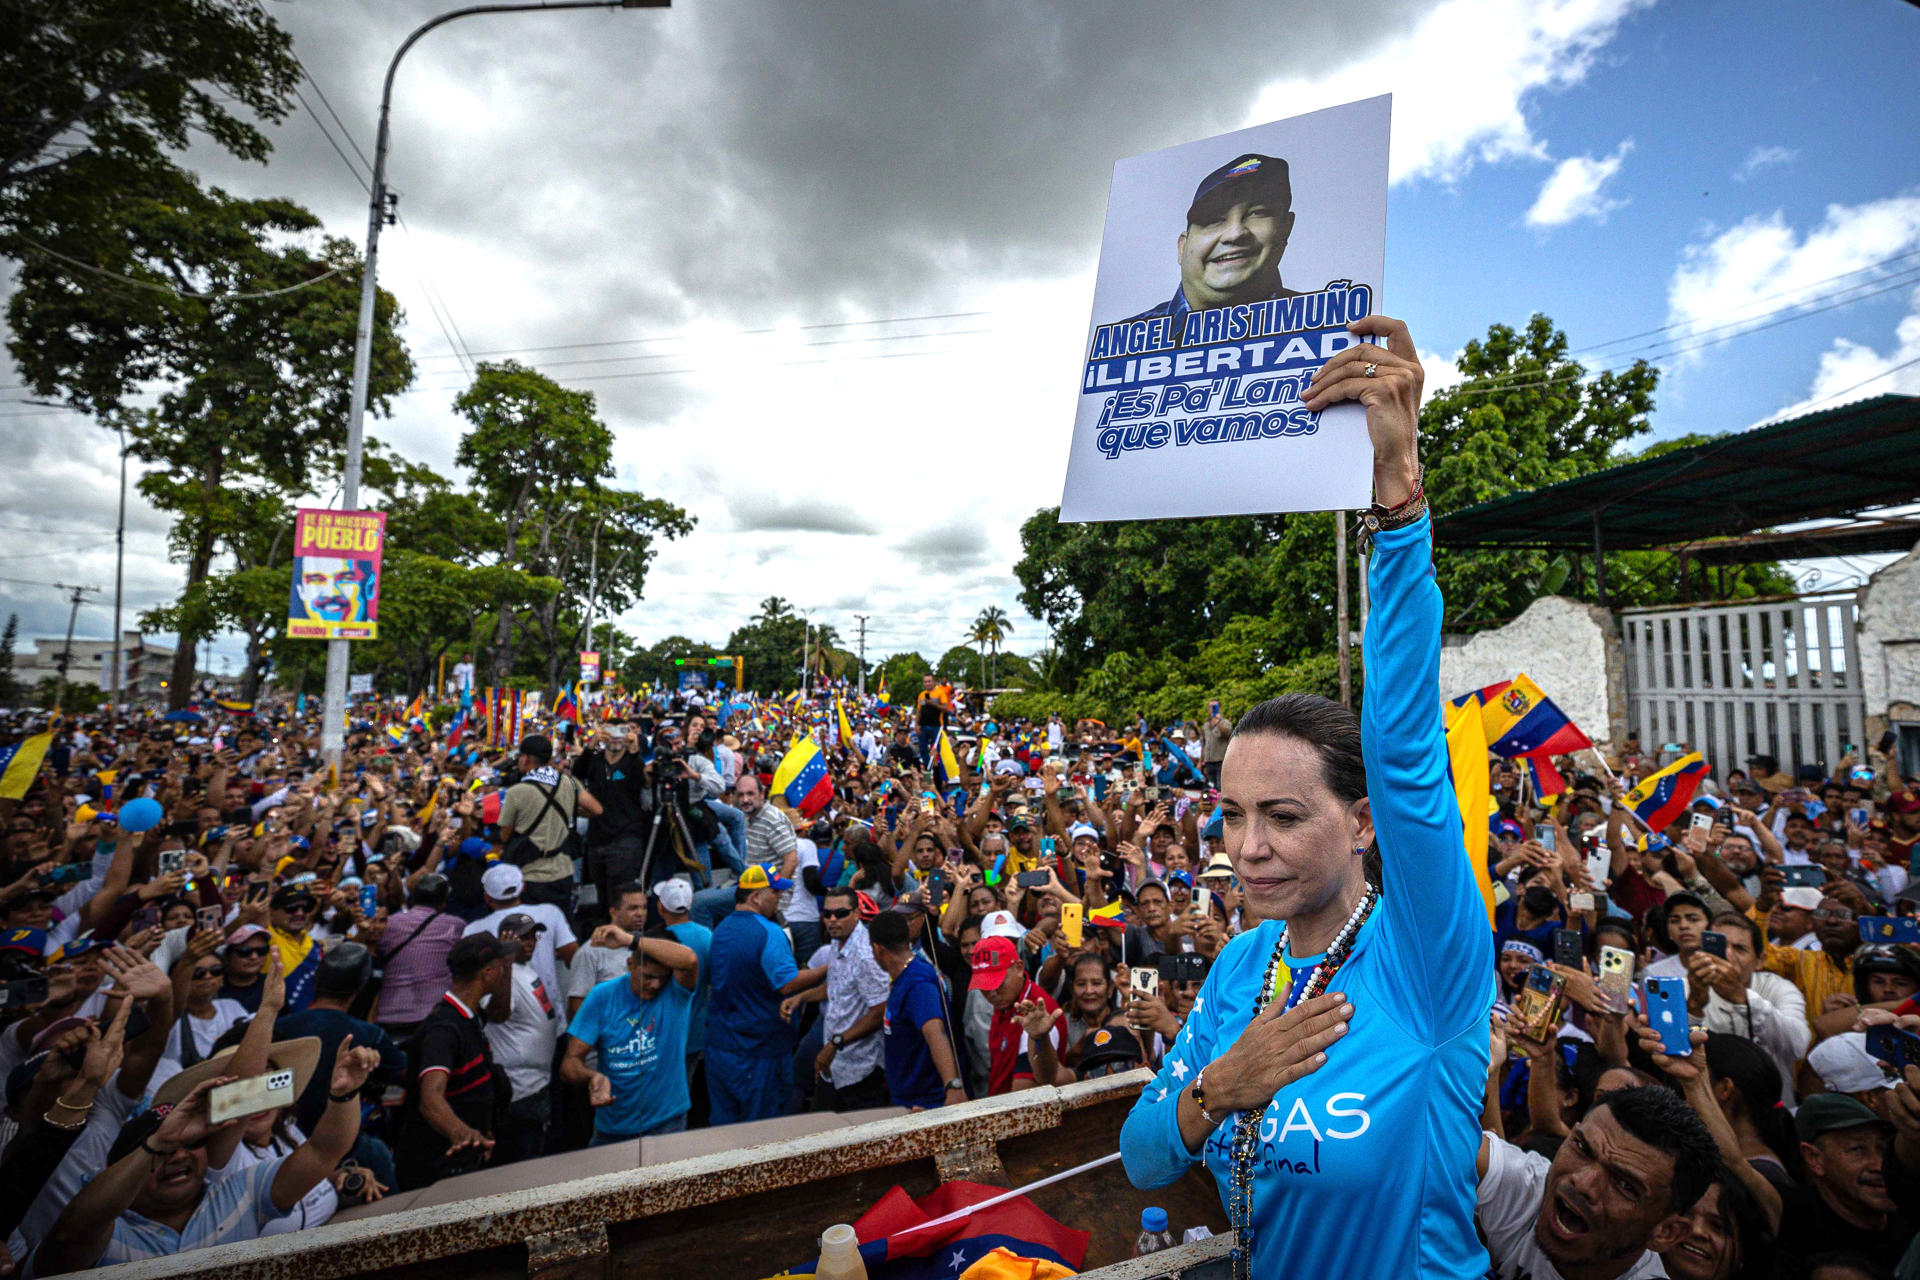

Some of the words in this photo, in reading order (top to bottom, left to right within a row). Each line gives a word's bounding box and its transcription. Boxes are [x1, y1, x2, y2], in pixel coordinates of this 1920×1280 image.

[1090, 317, 1175, 360] ANGEL
[1181, 281, 1370, 348] ARISTIMUÑO
[1097, 388, 1158, 429] ¡Es
[1155, 380, 1222, 417] Pa'
[1220, 368, 1319, 410] Lant
[1097, 421, 1171, 460] que
[1175, 408, 1322, 447] vamos!
[302, 525, 379, 552] PUEBLO
[1219, 1092, 1371, 1142] GAS
